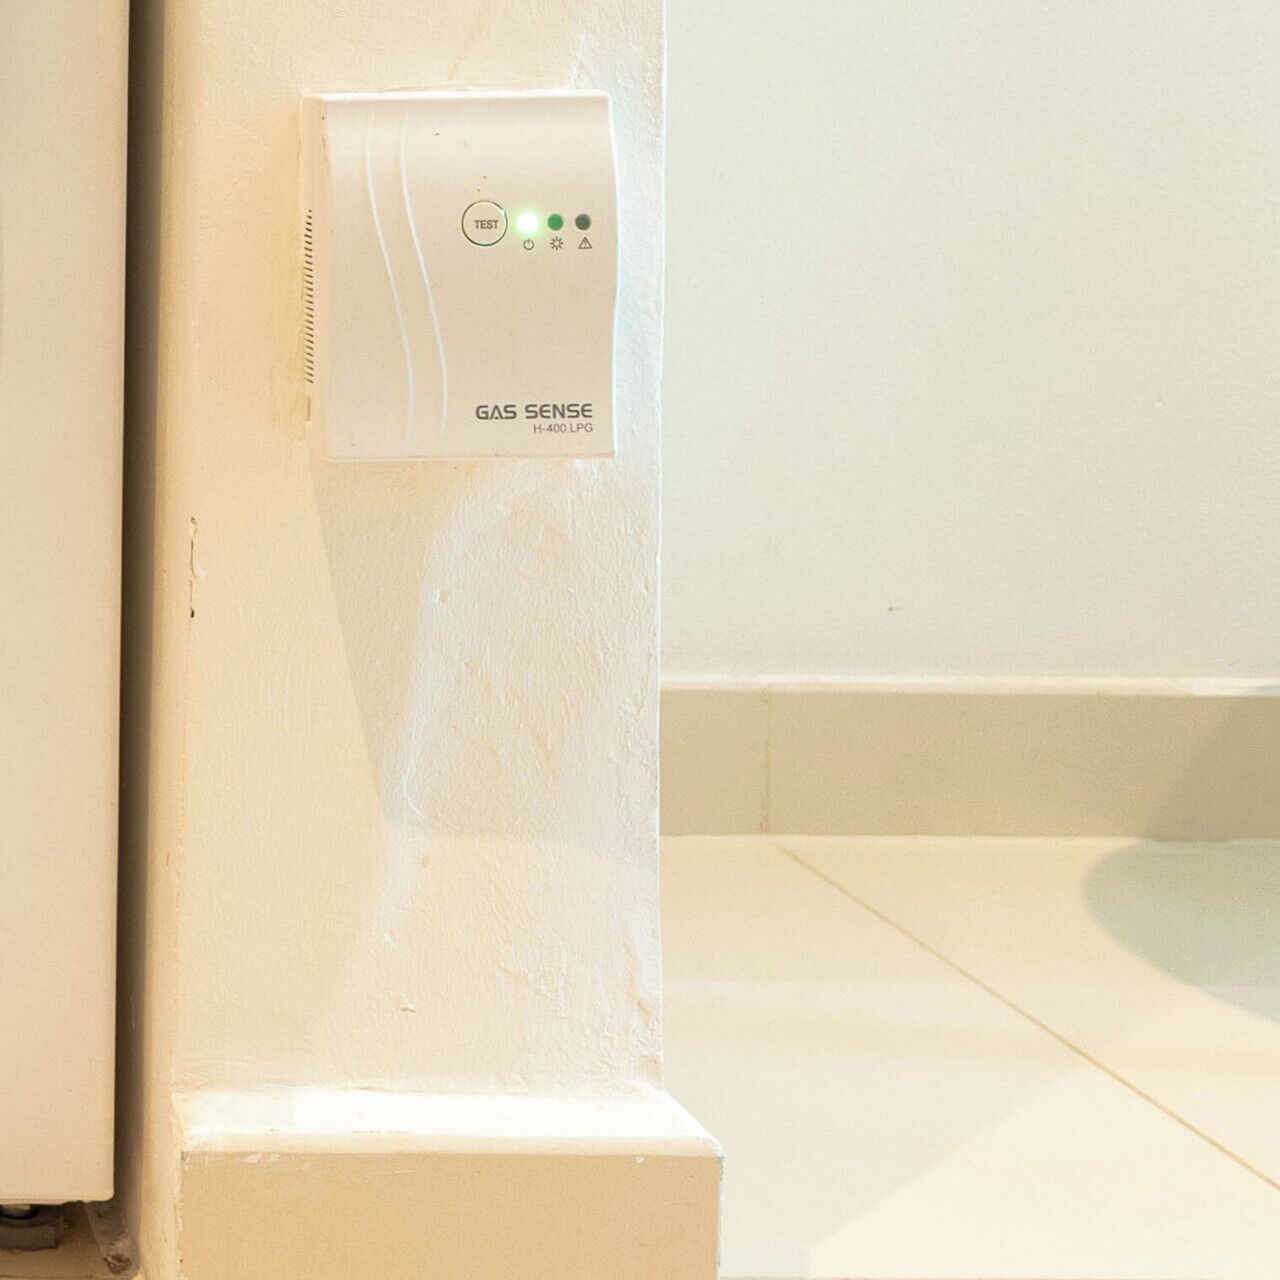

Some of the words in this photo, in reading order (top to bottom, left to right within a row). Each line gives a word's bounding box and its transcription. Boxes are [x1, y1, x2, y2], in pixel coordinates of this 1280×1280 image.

[473, 219, 500, 230] TEST
[475, 404, 518, 421] GAS
[524, 403, 593, 420] SENSE
